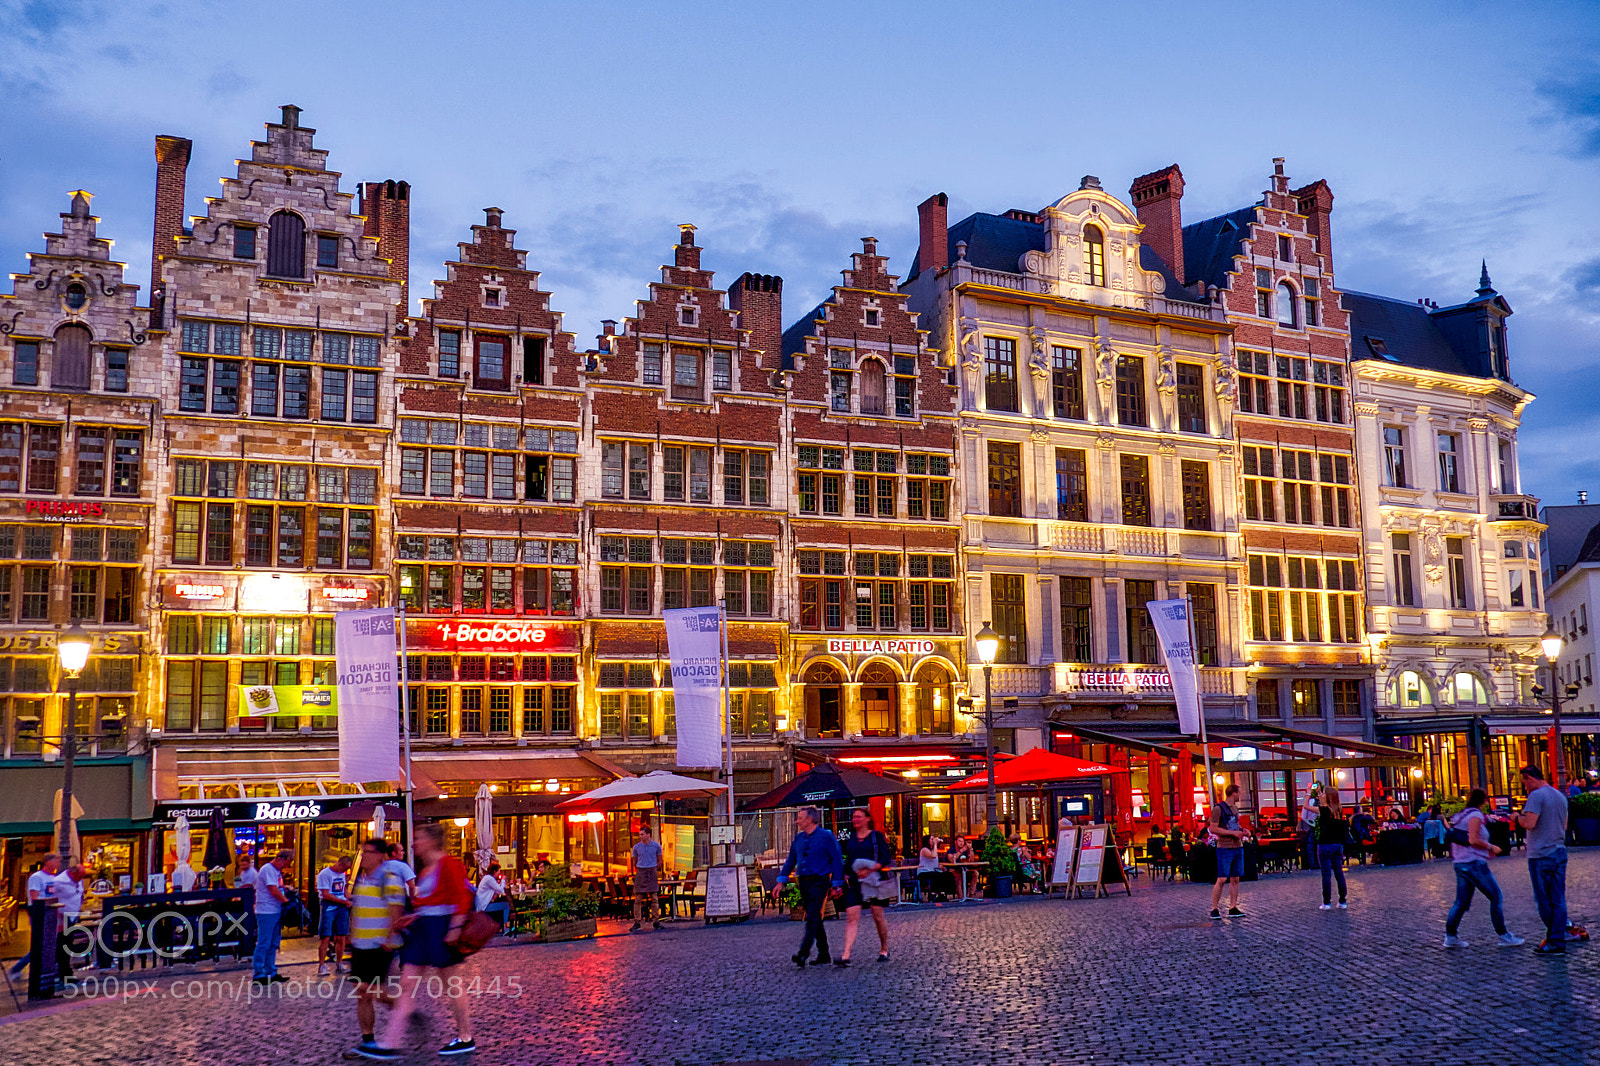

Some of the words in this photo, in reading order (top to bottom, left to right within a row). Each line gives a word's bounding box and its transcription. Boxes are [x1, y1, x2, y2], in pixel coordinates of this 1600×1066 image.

[26, 500, 103, 516] PRIMUS
[175, 584, 225, 597] PRIMUS
[322, 587, 368, 599] PRIMUS
[456, 624, 546, 642] Braboke
[829, 640, 883, 652] BELLA
[887, 640, 934, 653] PATIO
[1086, 673, 1131, 686] BELLA
[1135, 674, 1171, 687] PATIO
[167, 807, 230, 818] restaurt
[254, 801, 321, 820] Balto's
